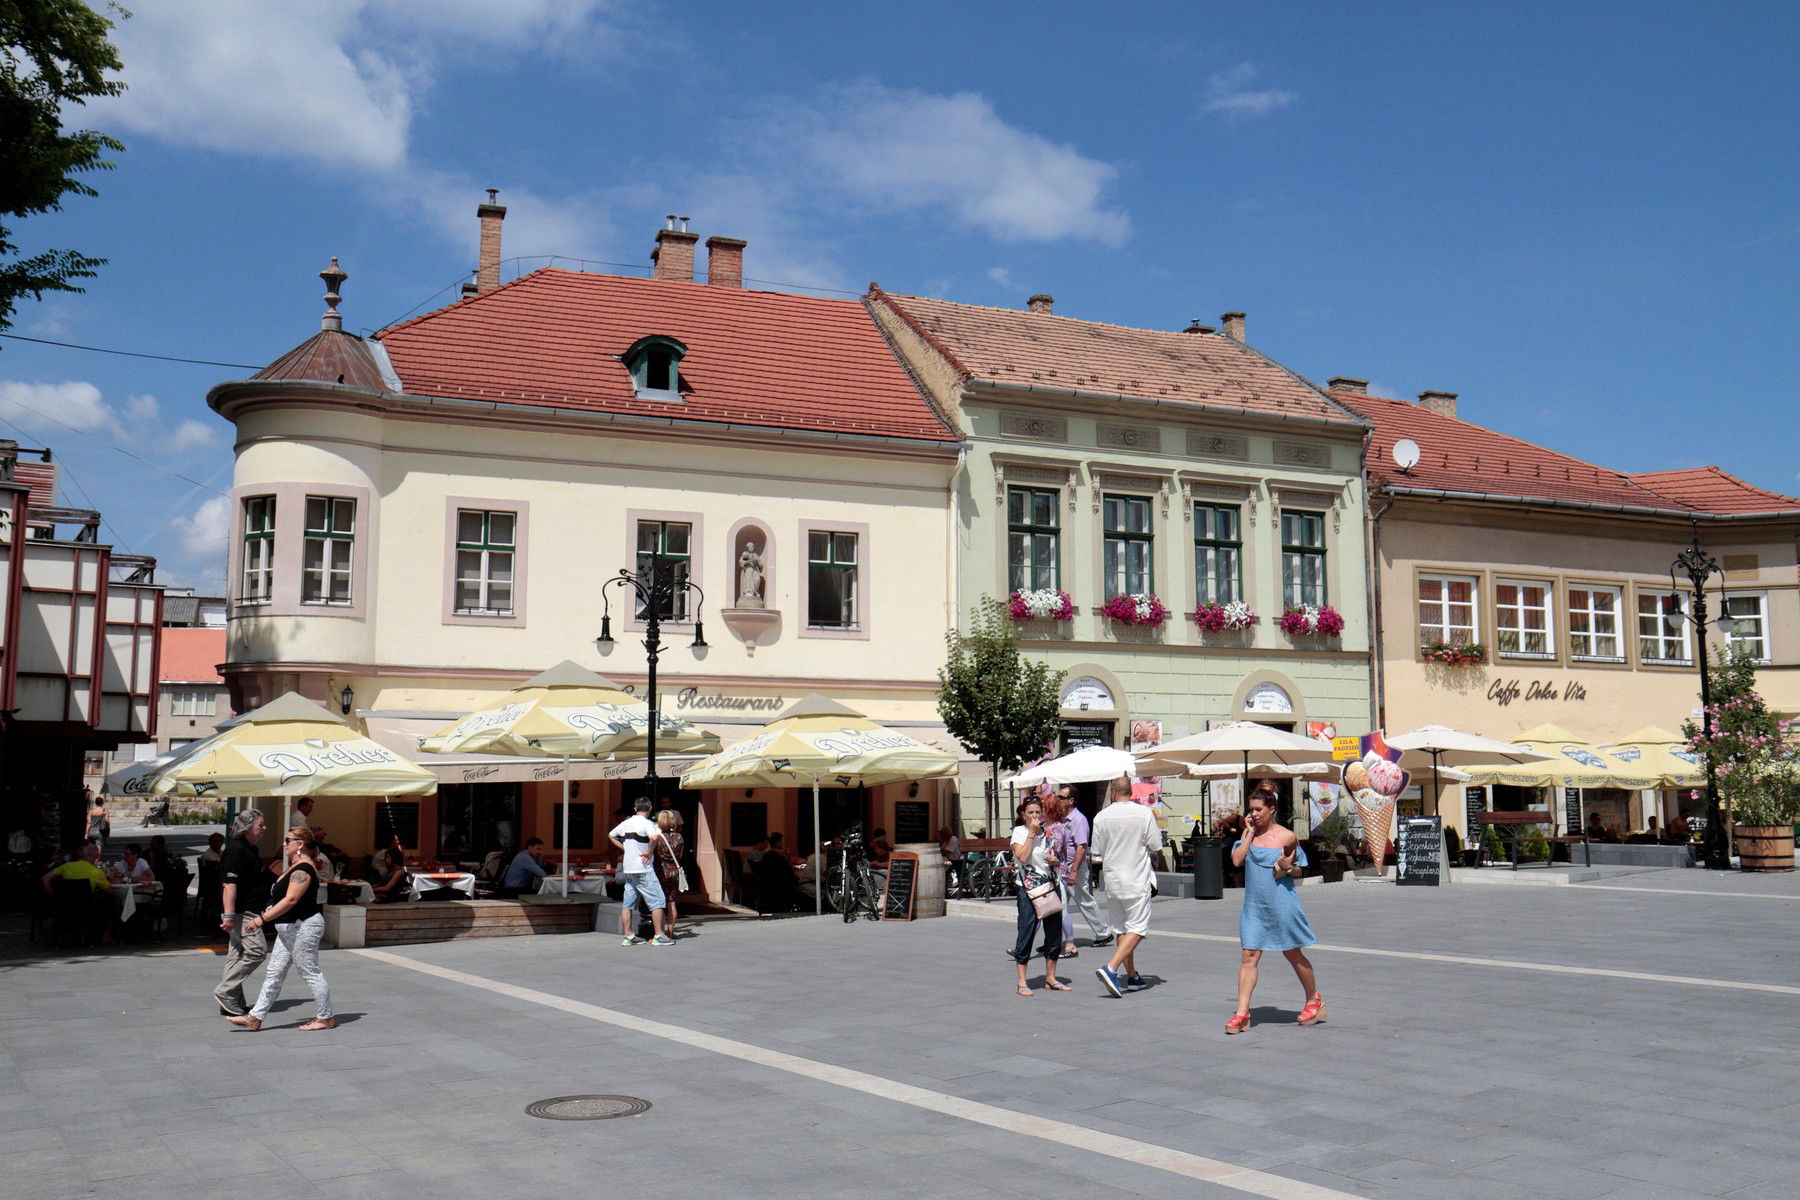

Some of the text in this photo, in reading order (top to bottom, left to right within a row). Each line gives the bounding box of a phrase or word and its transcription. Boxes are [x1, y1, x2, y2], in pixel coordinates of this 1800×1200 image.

[677, 686, 784, 711] Restaurant
[1525, 680, 1558, 701] Dolce
[1563, 680, 1587, 701] Vita
[813, 732, 918, 763] Dreher
[260, 744, 396, 786] Dreher
